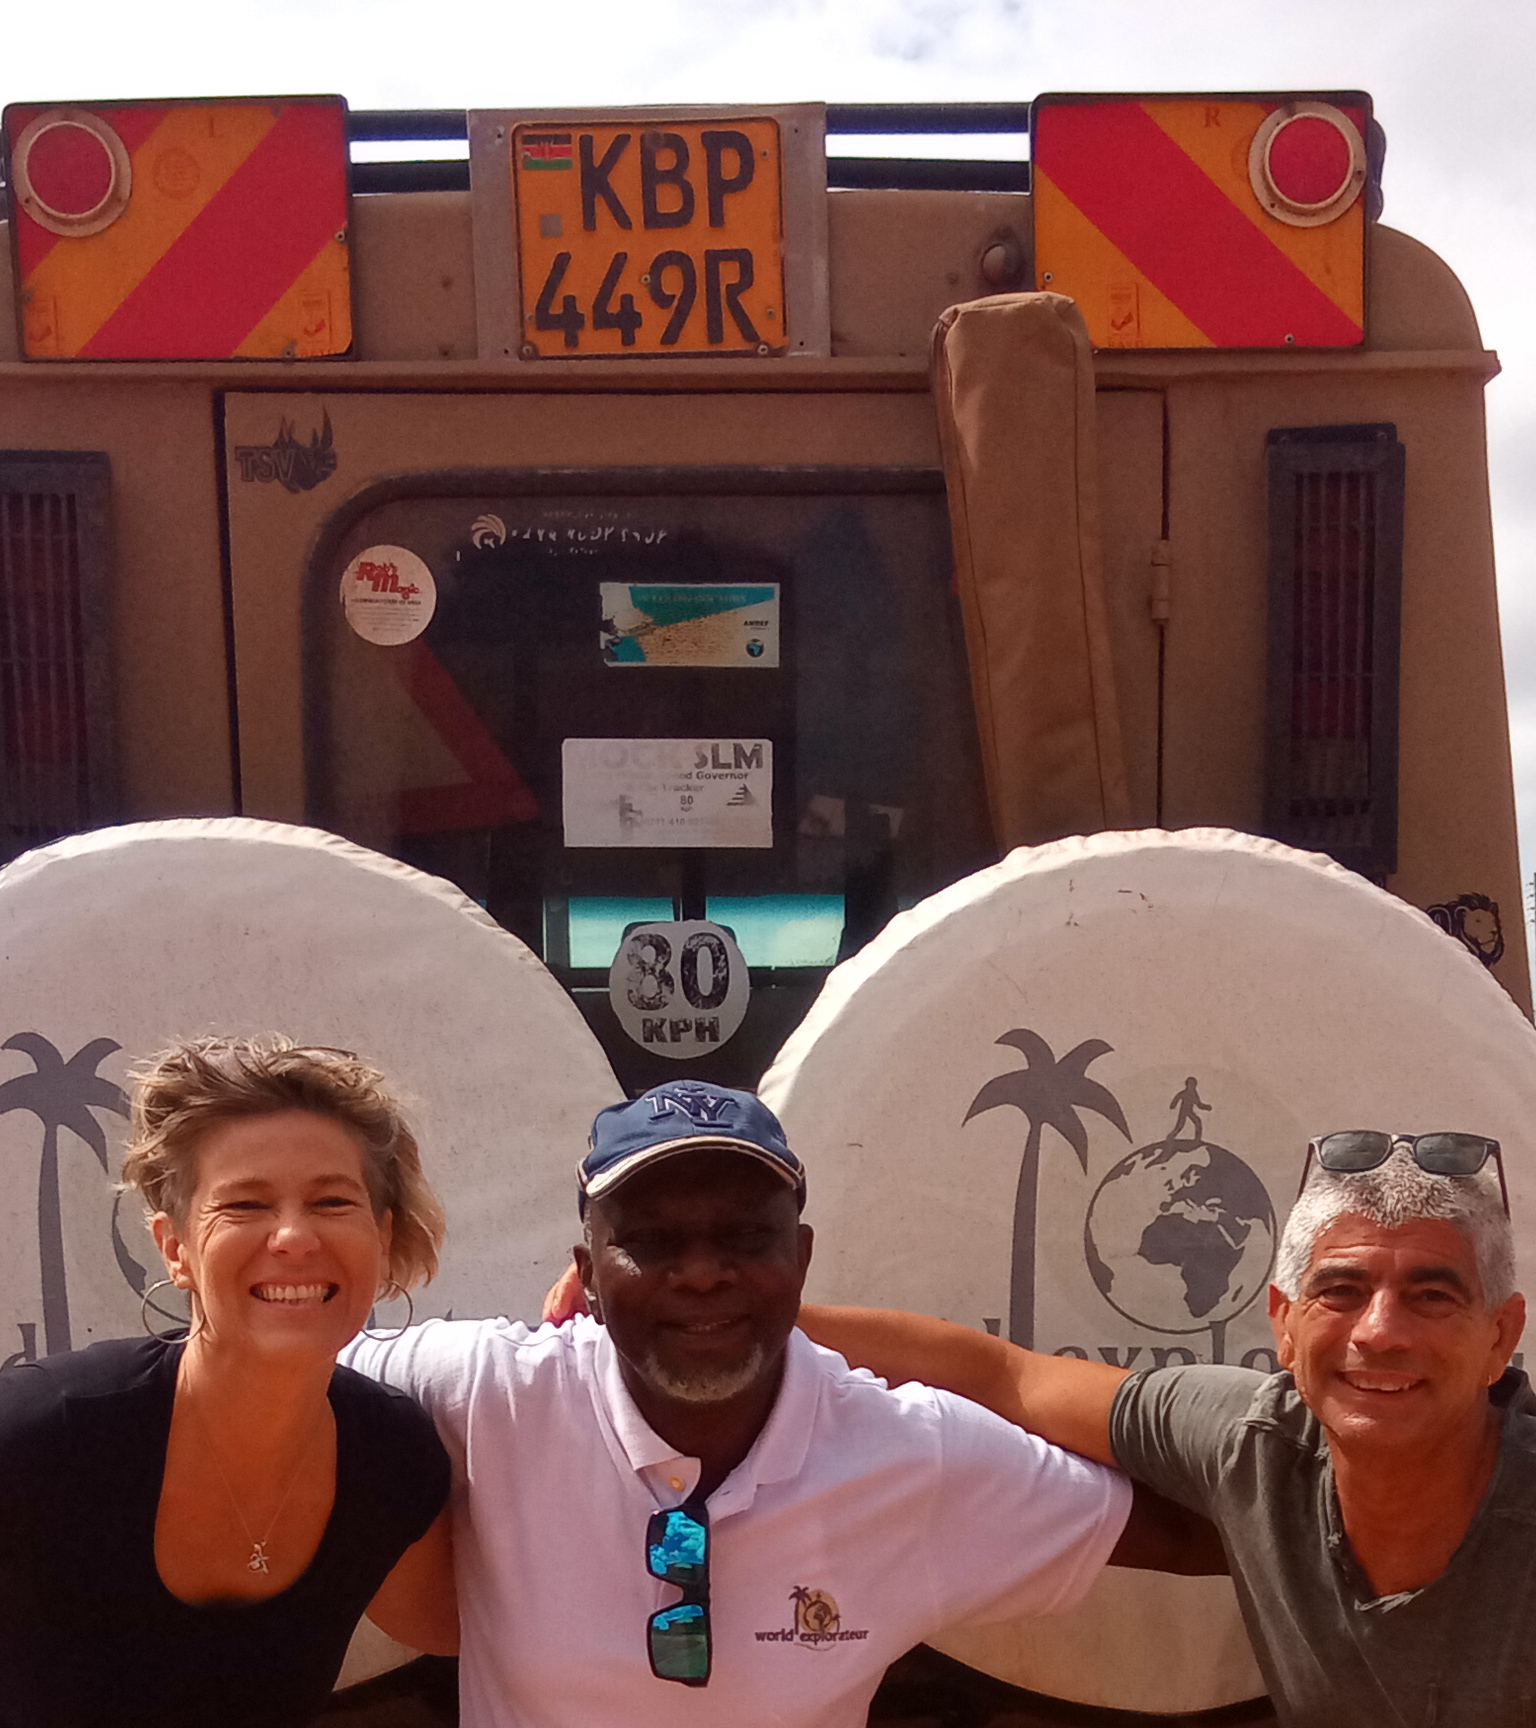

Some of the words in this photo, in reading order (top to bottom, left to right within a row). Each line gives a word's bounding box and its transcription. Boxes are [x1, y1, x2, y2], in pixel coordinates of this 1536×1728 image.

[579, 130, 755, 232] KBP
[535, 248, 761, 348] 449R
[234, 446, 298, 483] TSV
[693, 742, 764, 770] SLM
[695, 771, 749, 780] Governor
[679, 795, 694, 805] 80
[627, 932, 730, 1011] 80
[642, 1016, 720, 1043] KPH
[755, 1628, 794, 1642] world
